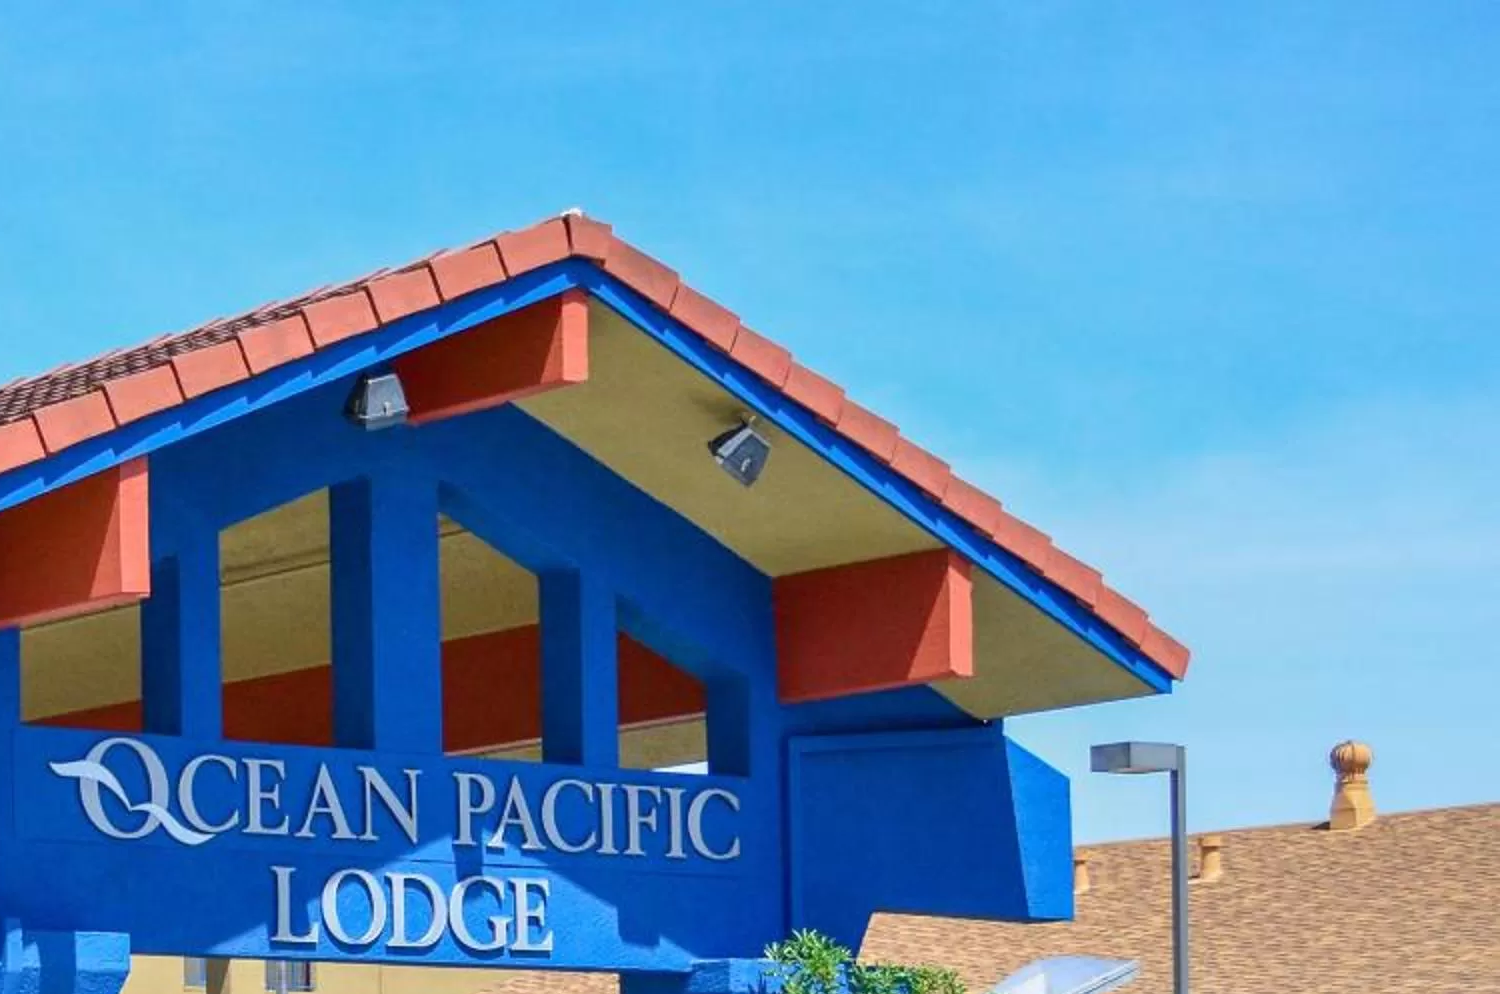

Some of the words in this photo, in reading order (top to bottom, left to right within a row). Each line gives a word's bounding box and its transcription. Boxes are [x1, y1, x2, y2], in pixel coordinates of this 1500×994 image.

[50, 737, 422, 845] OCEAN
[453, 771, 741, 860] PACIFIC
[269, 865, 553, 951] LODGE
